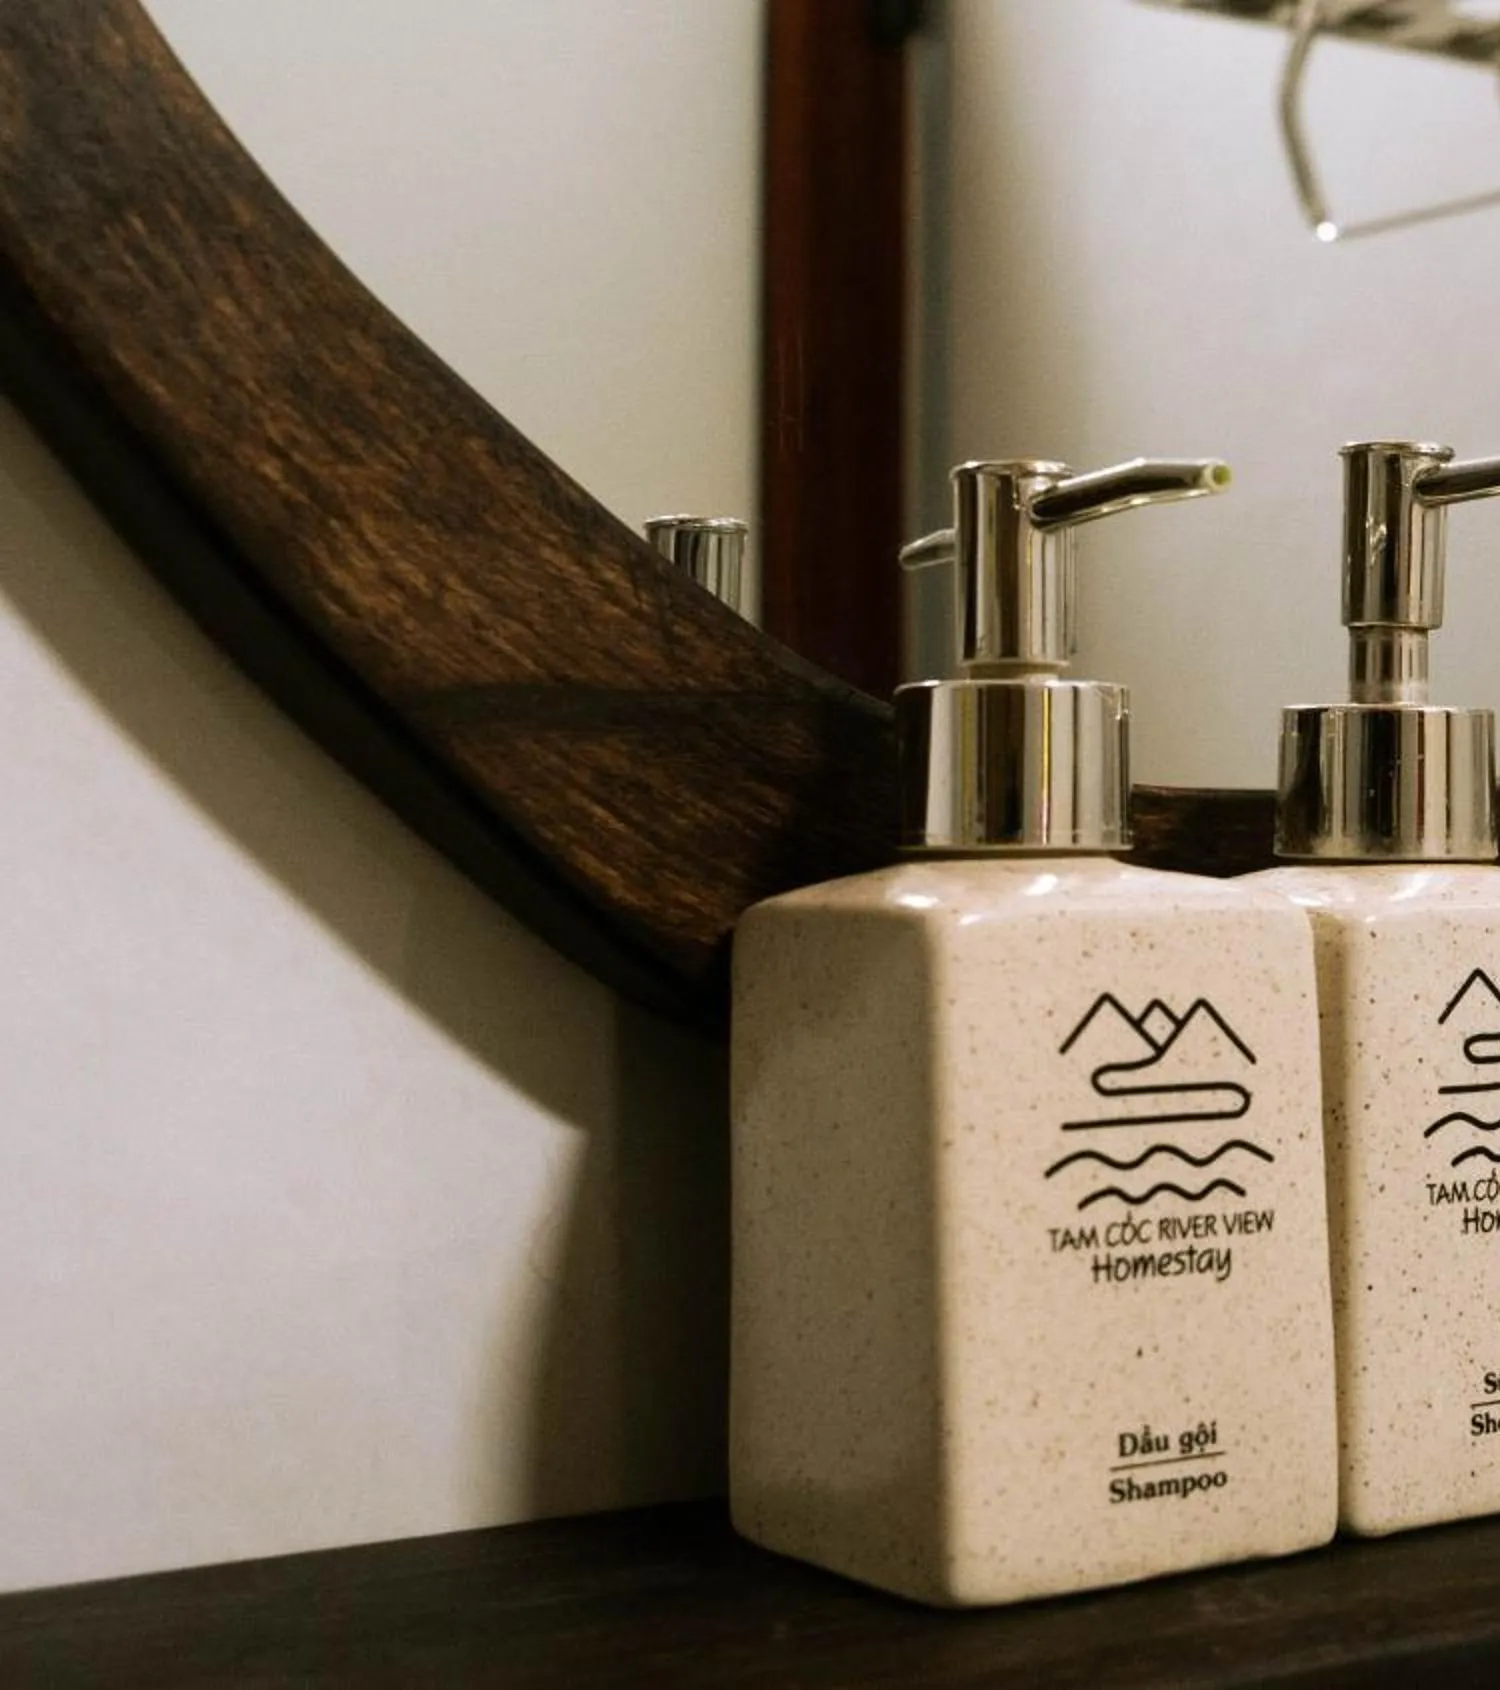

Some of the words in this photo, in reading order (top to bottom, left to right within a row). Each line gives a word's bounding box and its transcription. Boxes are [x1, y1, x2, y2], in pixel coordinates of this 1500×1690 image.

[1426, 1181, 1470, 1206] TAM
[1048, 1226, 1099, 1252] TAM
[1157, 1214, 1217, 1242] RIVER
[1222, 1209, 1275, 1236] VIEW
[1091, 1244, 1232, 1283] Homestay
[1108, 1471, 1228, 1505] Shampoo
